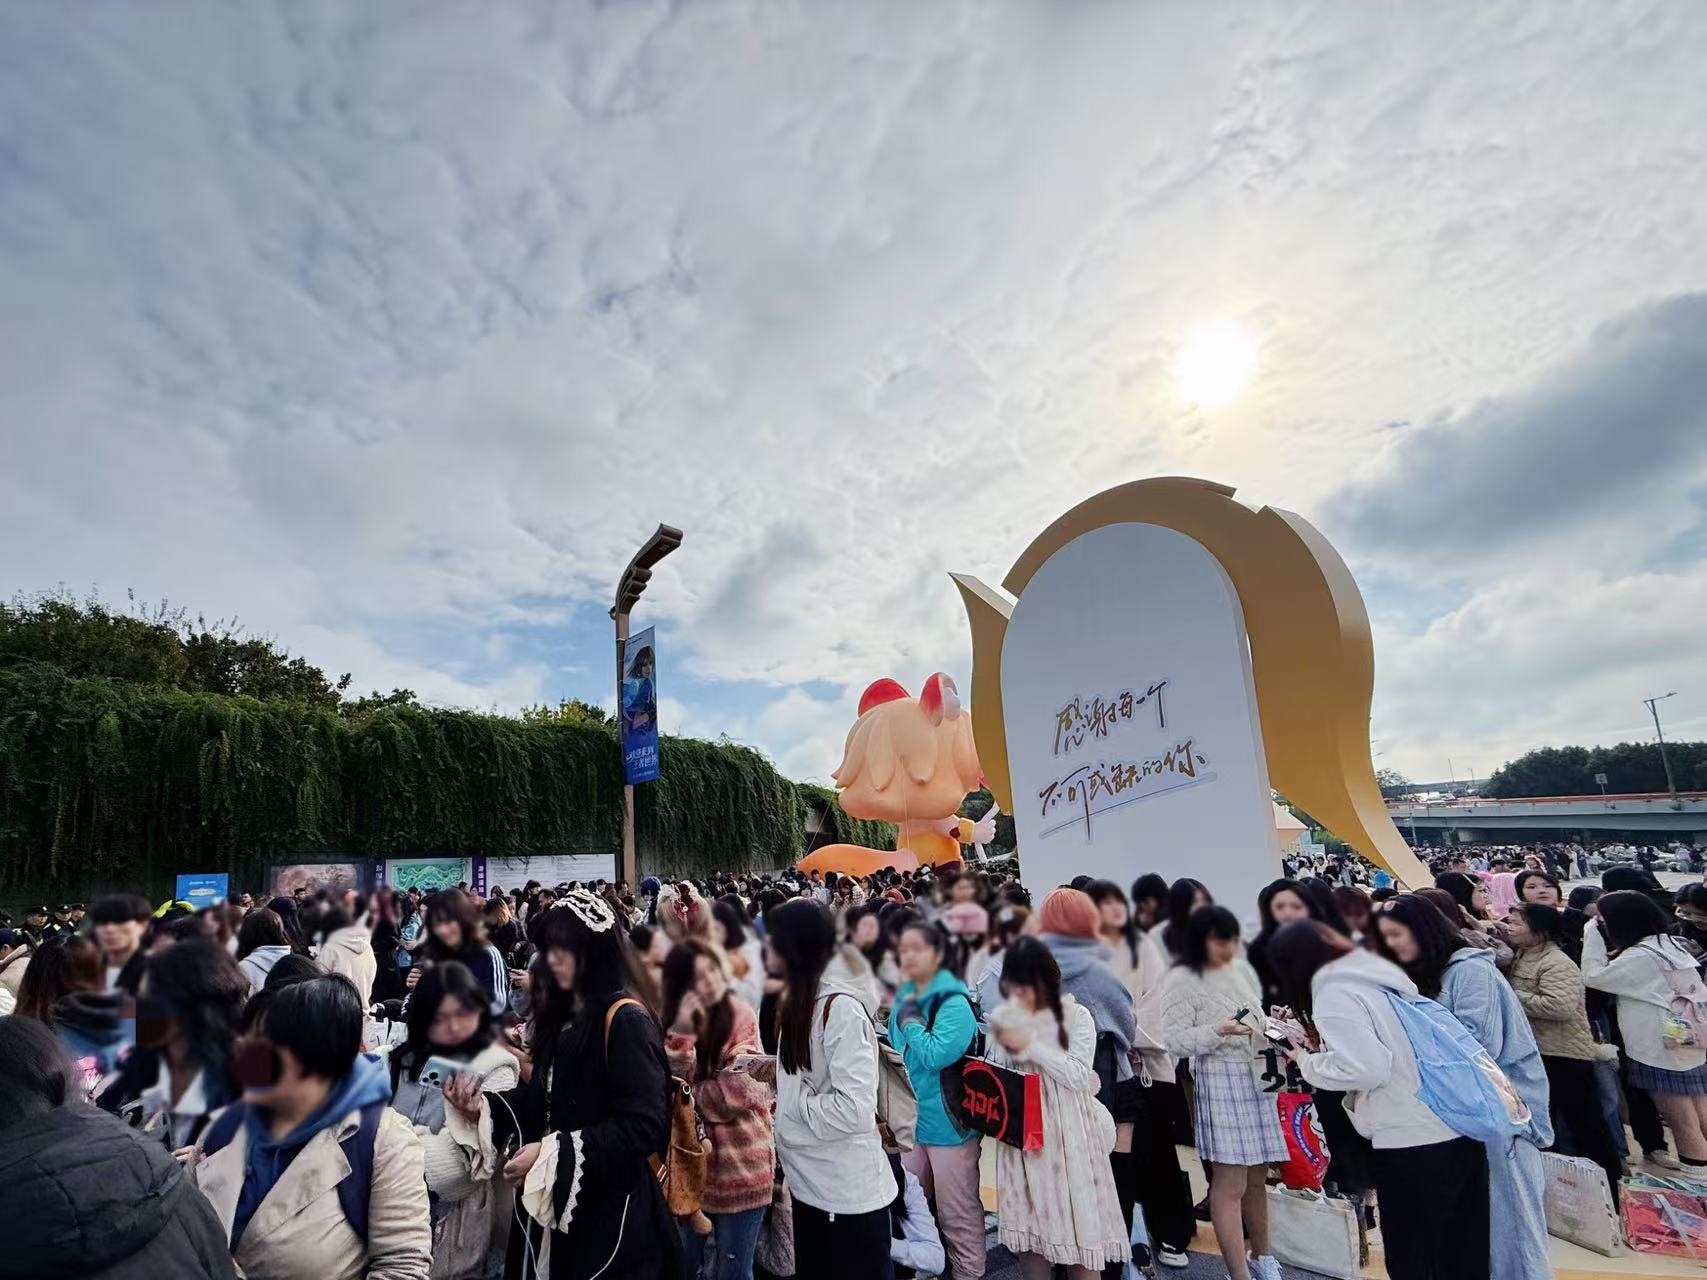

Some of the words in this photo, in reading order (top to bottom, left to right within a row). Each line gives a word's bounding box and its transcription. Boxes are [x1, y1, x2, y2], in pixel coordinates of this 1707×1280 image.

[1053, 680, 1168, 756] 感谢每一个
[1038, 739, 1207, 841] 不可或缺的你
